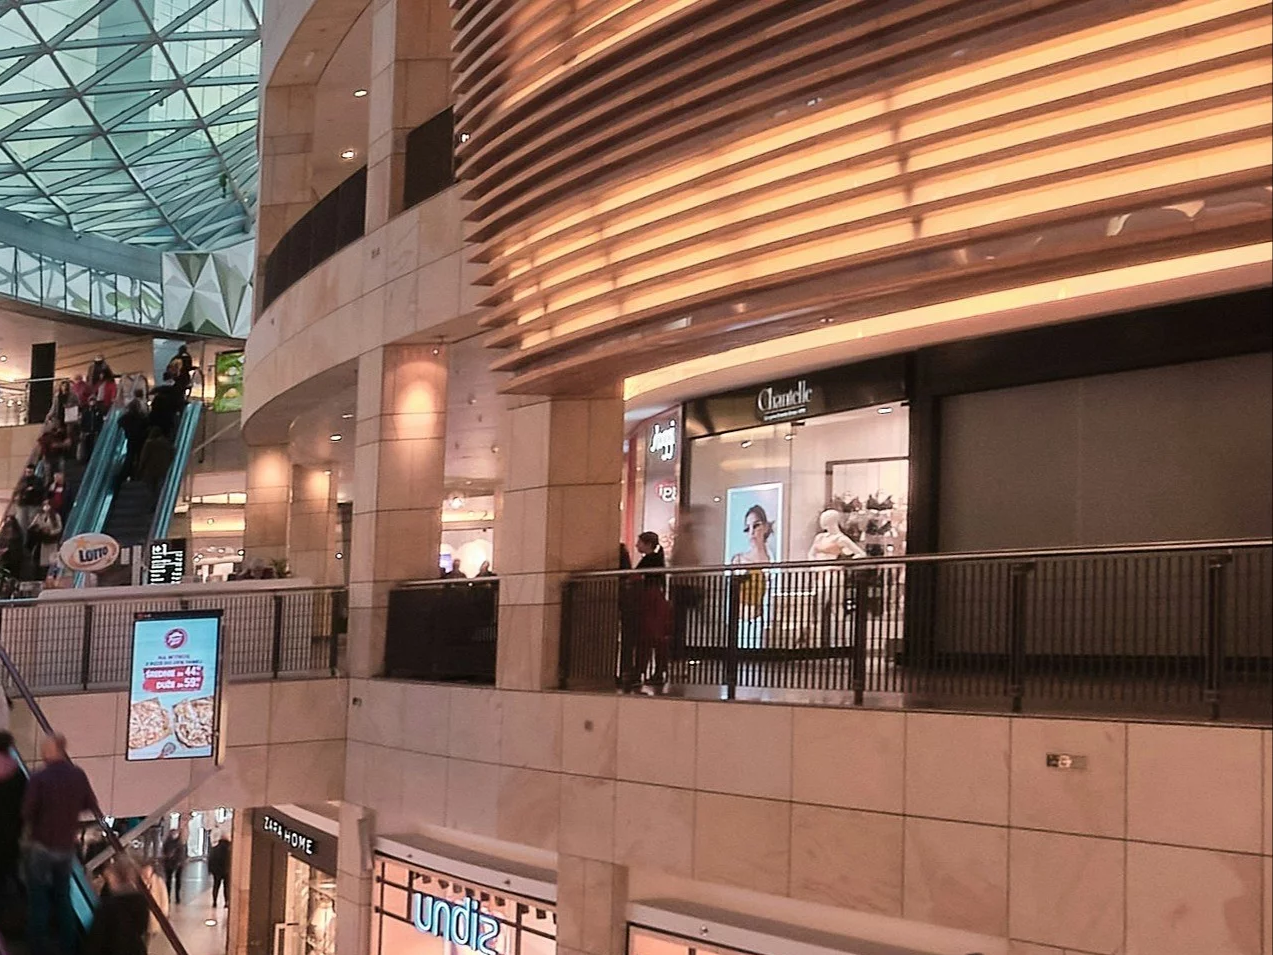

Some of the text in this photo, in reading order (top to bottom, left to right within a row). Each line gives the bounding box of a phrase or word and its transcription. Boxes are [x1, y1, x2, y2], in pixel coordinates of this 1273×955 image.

[758, 380, 813, 411] Chantelle
[79, 546, 108, 562] LOTTO
[284, 830, 313, 855] HOME
